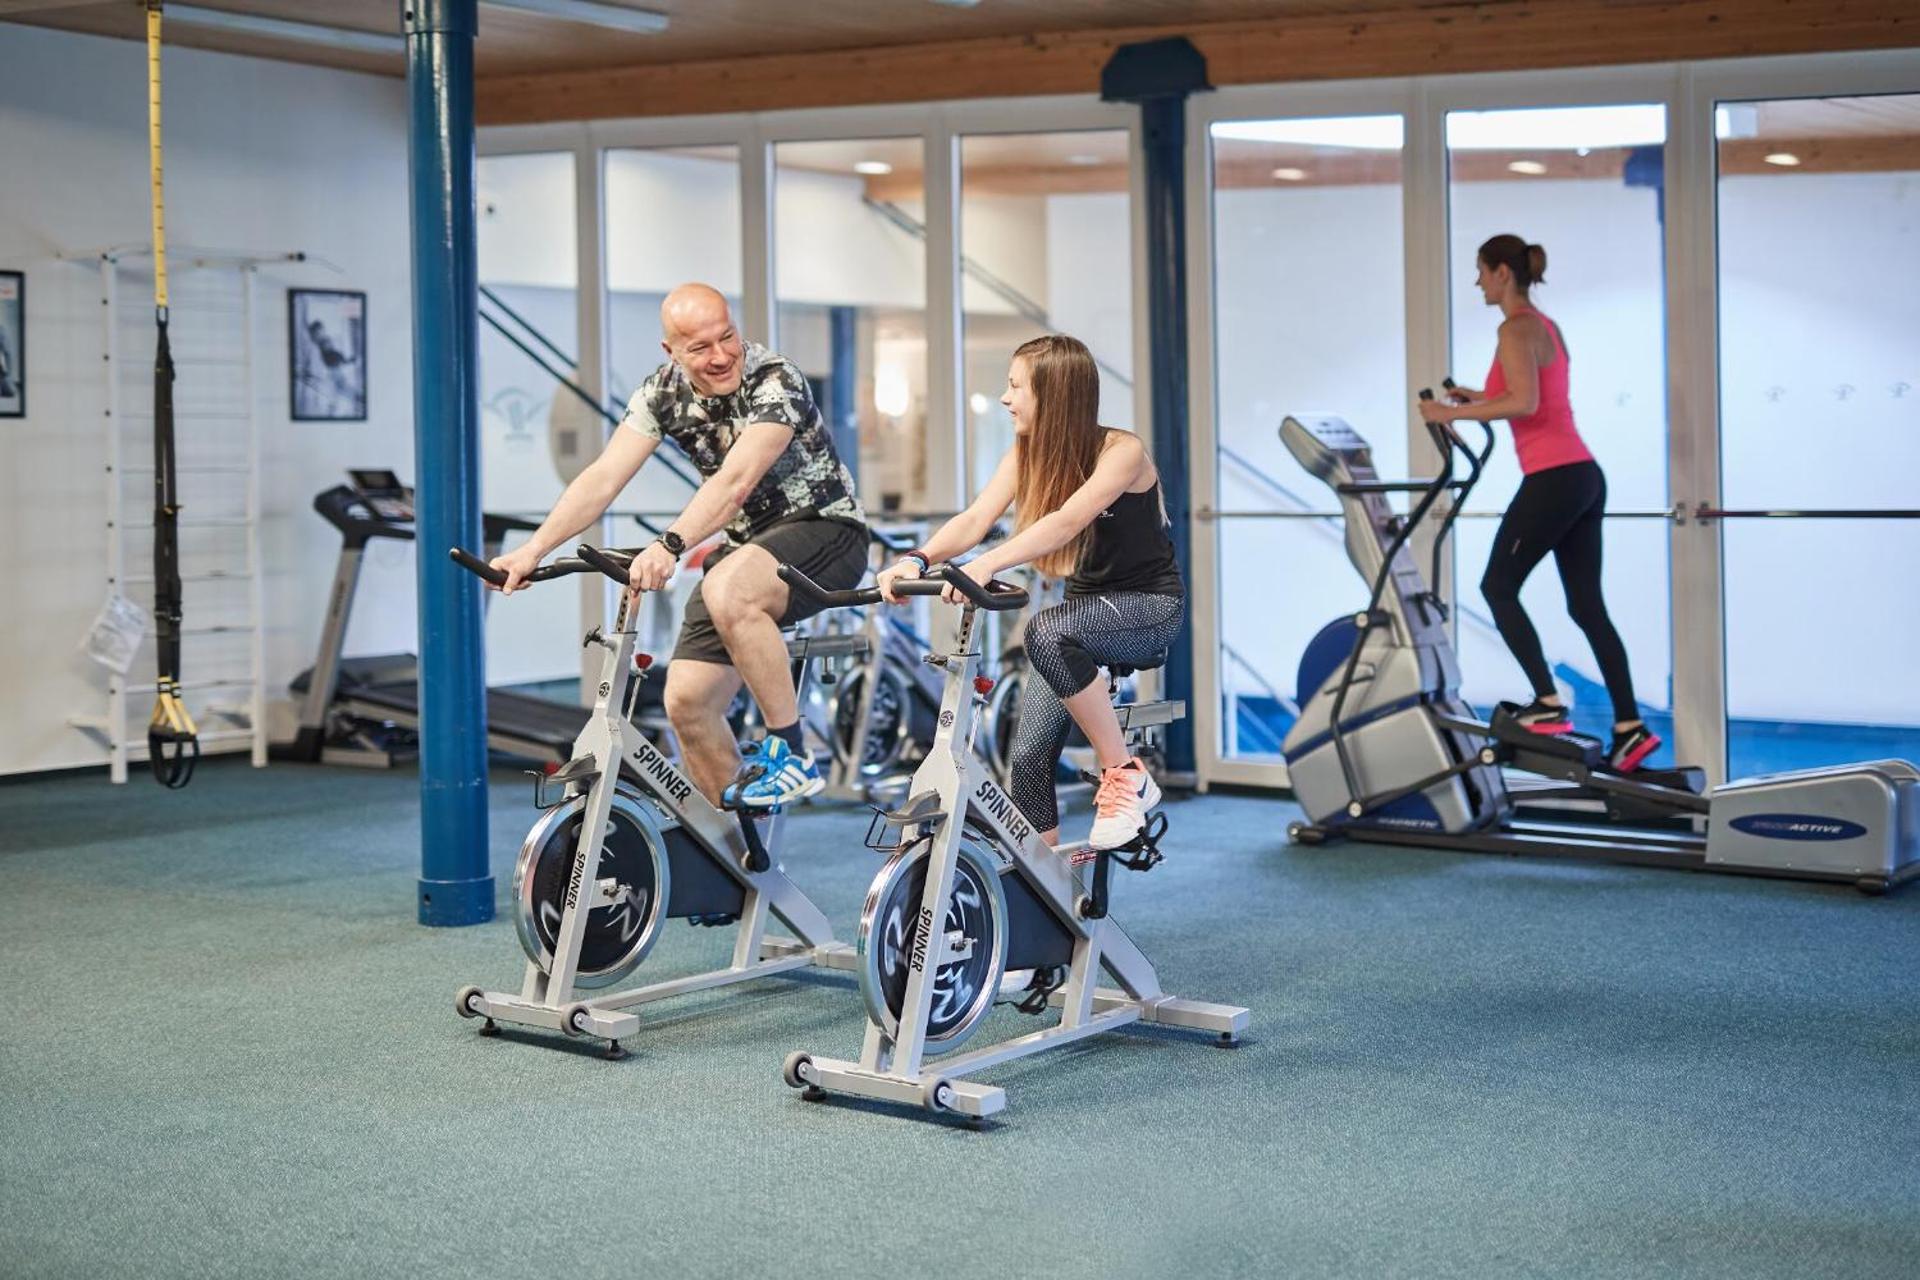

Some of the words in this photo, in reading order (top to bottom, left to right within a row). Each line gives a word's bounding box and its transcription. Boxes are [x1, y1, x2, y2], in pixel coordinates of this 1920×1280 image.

[633, 744, 692, 803] SPINNER
[976, 780, 1030, 842] SPINNER
[566, 851, 586, 910] SPINNER
[911, 907, 933, 973] SPINNER
